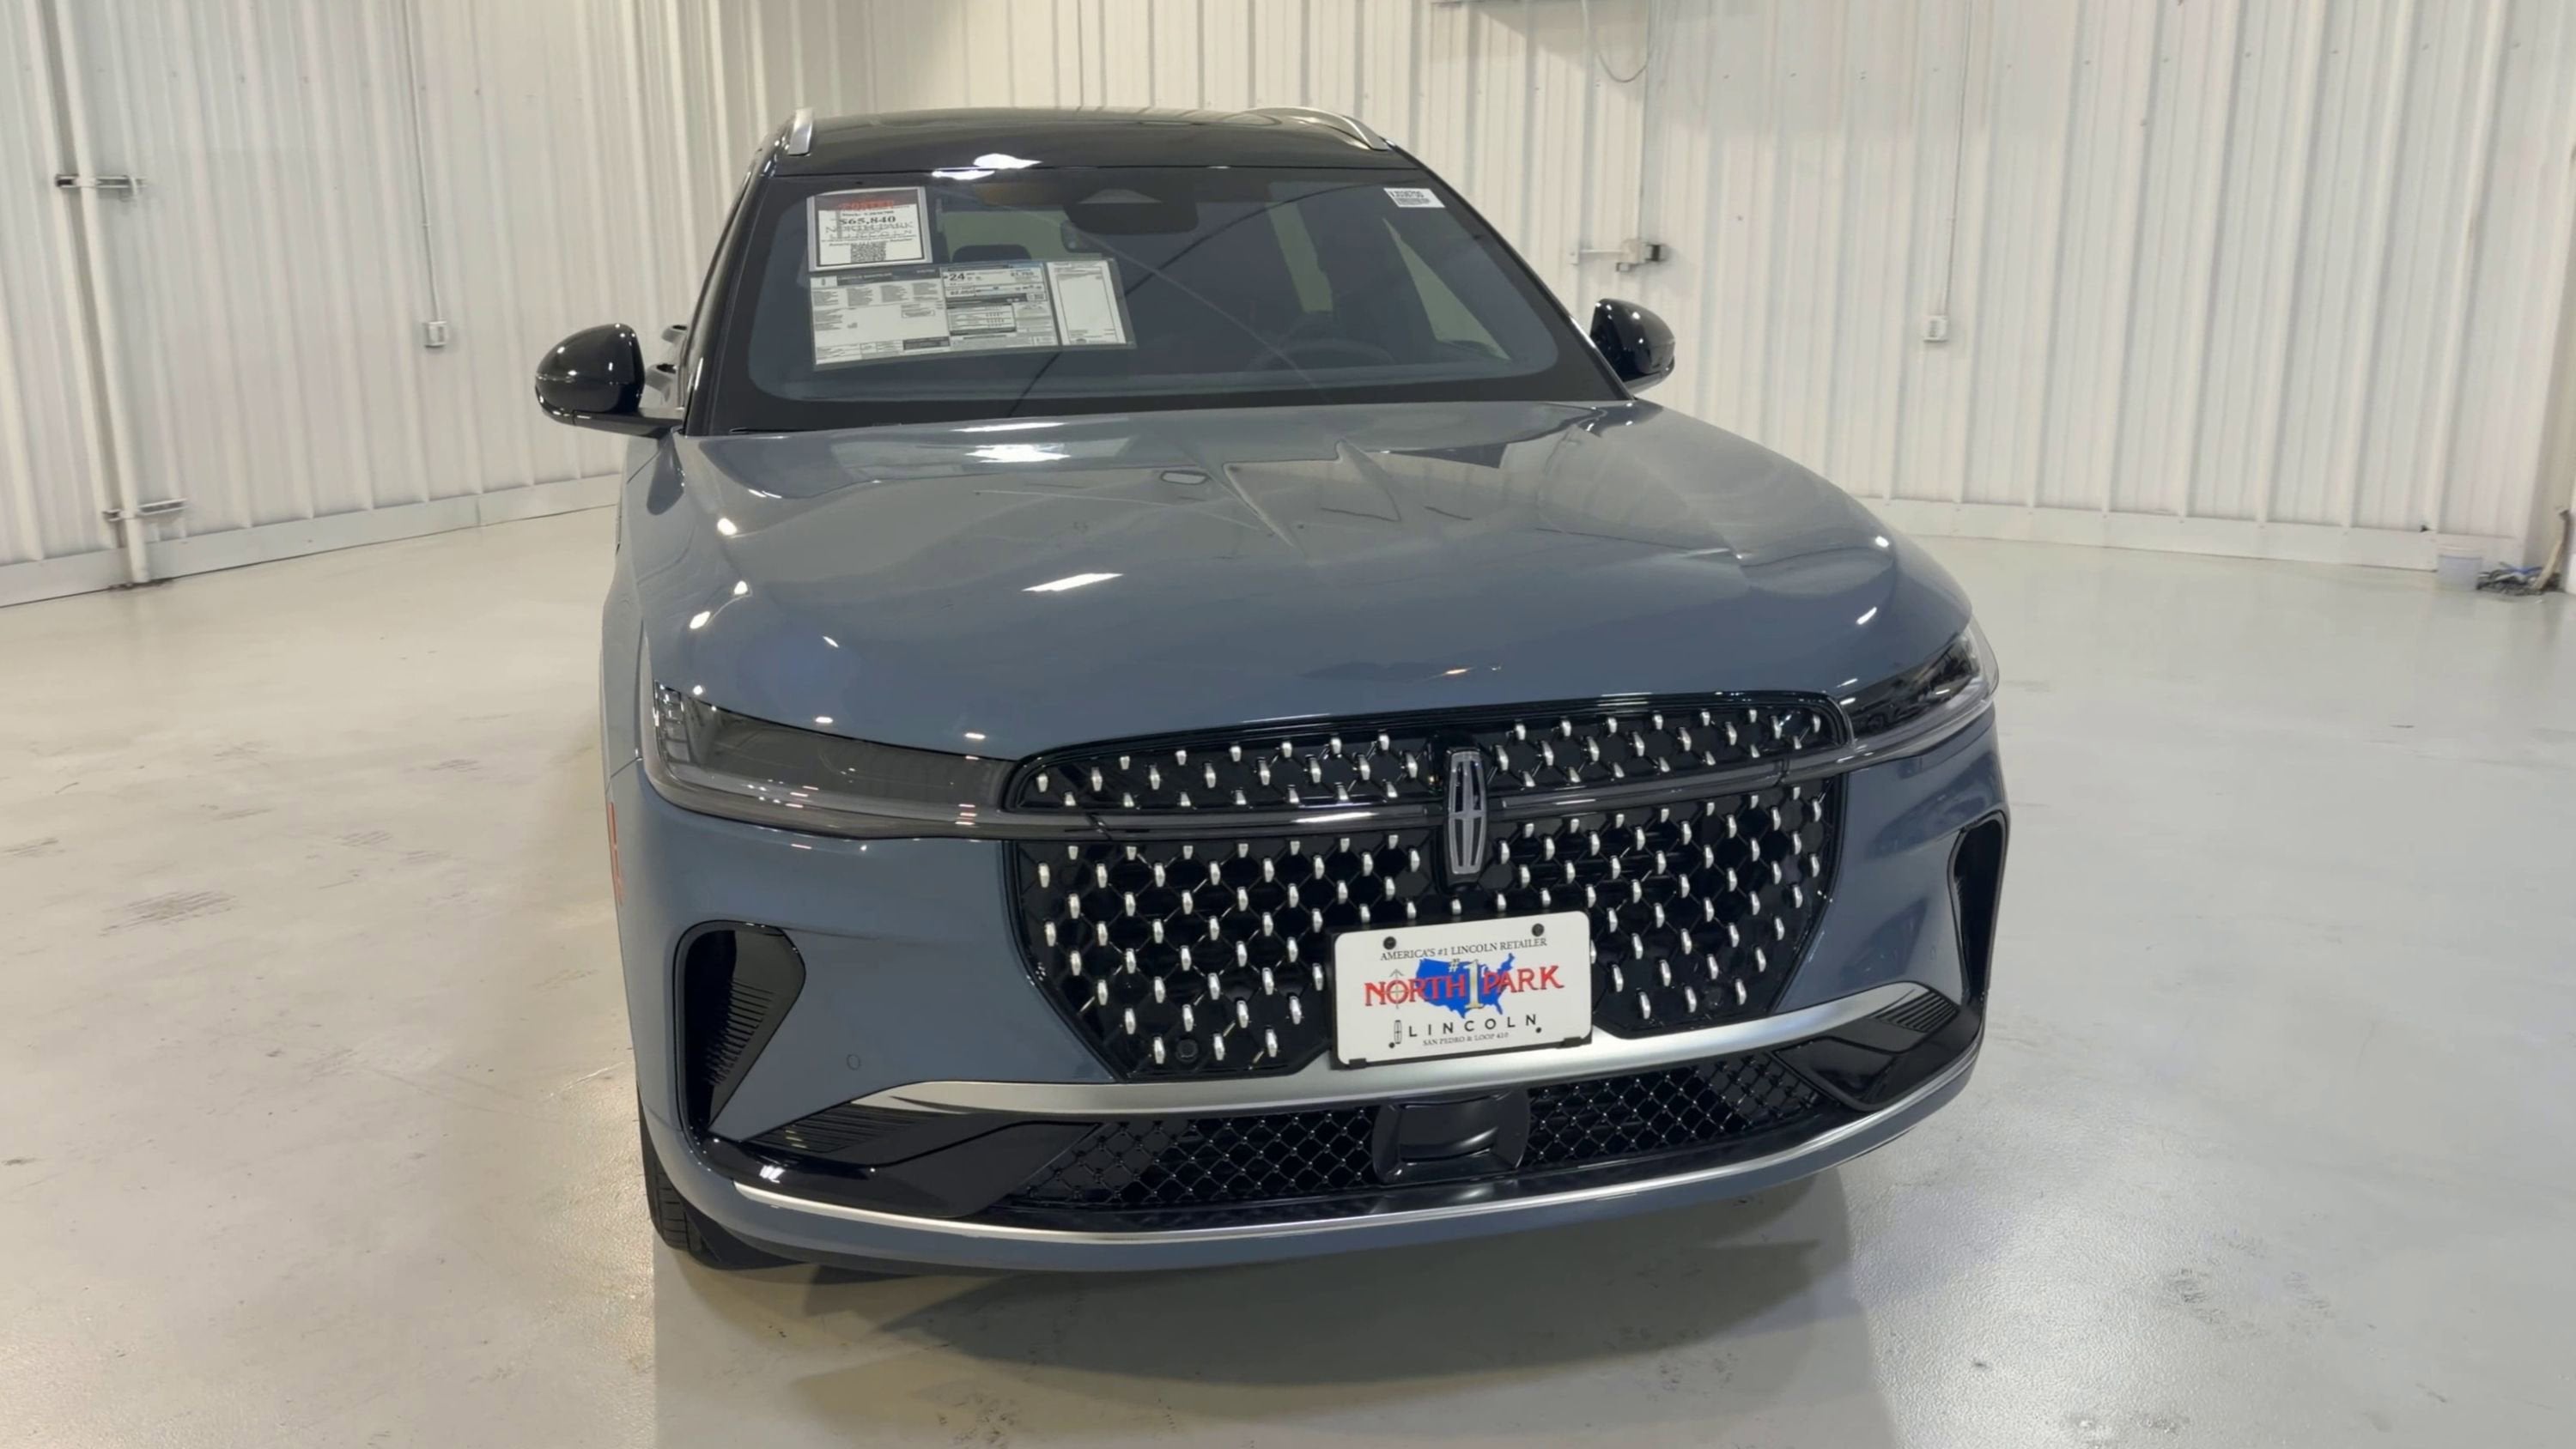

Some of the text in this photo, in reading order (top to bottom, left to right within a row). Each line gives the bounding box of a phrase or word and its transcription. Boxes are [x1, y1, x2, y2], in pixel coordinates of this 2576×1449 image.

[949, 273, 966, 282] 24
[1381, 937, 1548, 961] AMERICA'S #1 LINCOLN RETAILER
[1364, 973, 1467, 1007] NORTH
[1483, 965, 1564, 994] PARK
[1408, 1014, 1537, 1037] LINCOLN
